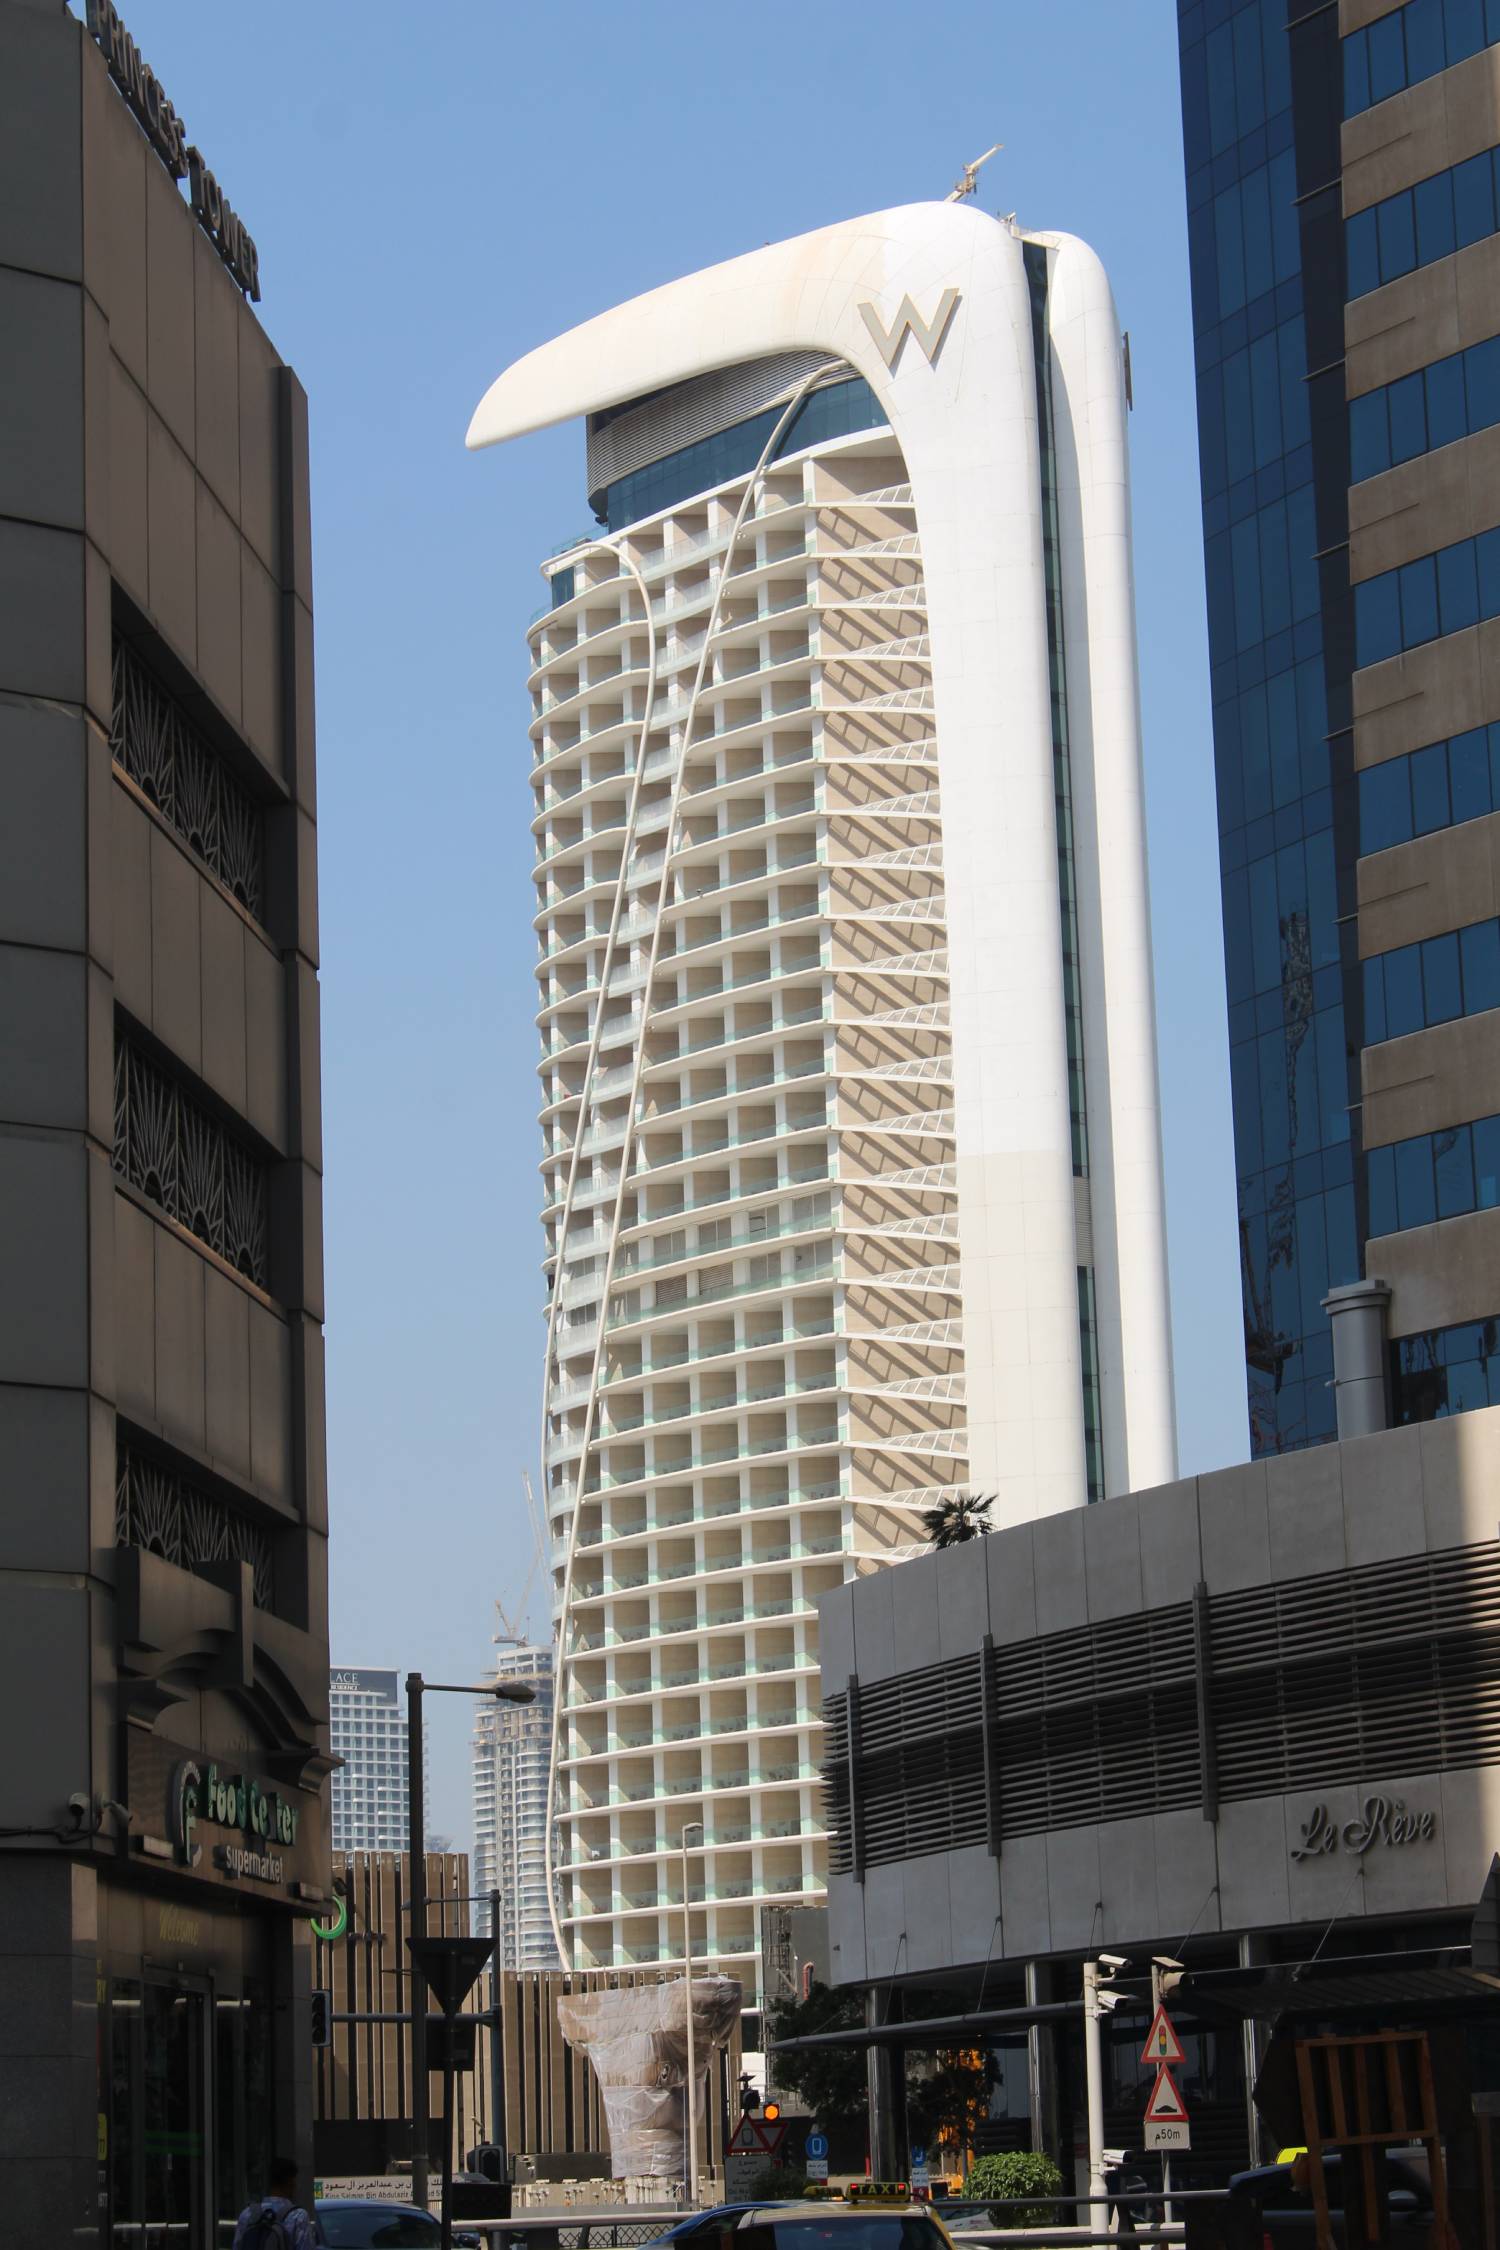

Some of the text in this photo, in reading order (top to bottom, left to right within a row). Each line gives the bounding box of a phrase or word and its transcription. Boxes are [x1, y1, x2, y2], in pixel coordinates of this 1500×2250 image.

[186, 146, 261, 302] TOWER
[857, 287, 960, 368] W
[1291, 1803, 1337, 1862] Le
[226, 1846, 283, 1882] supermarket
[859, 2183, 899, 2195] TAXI
